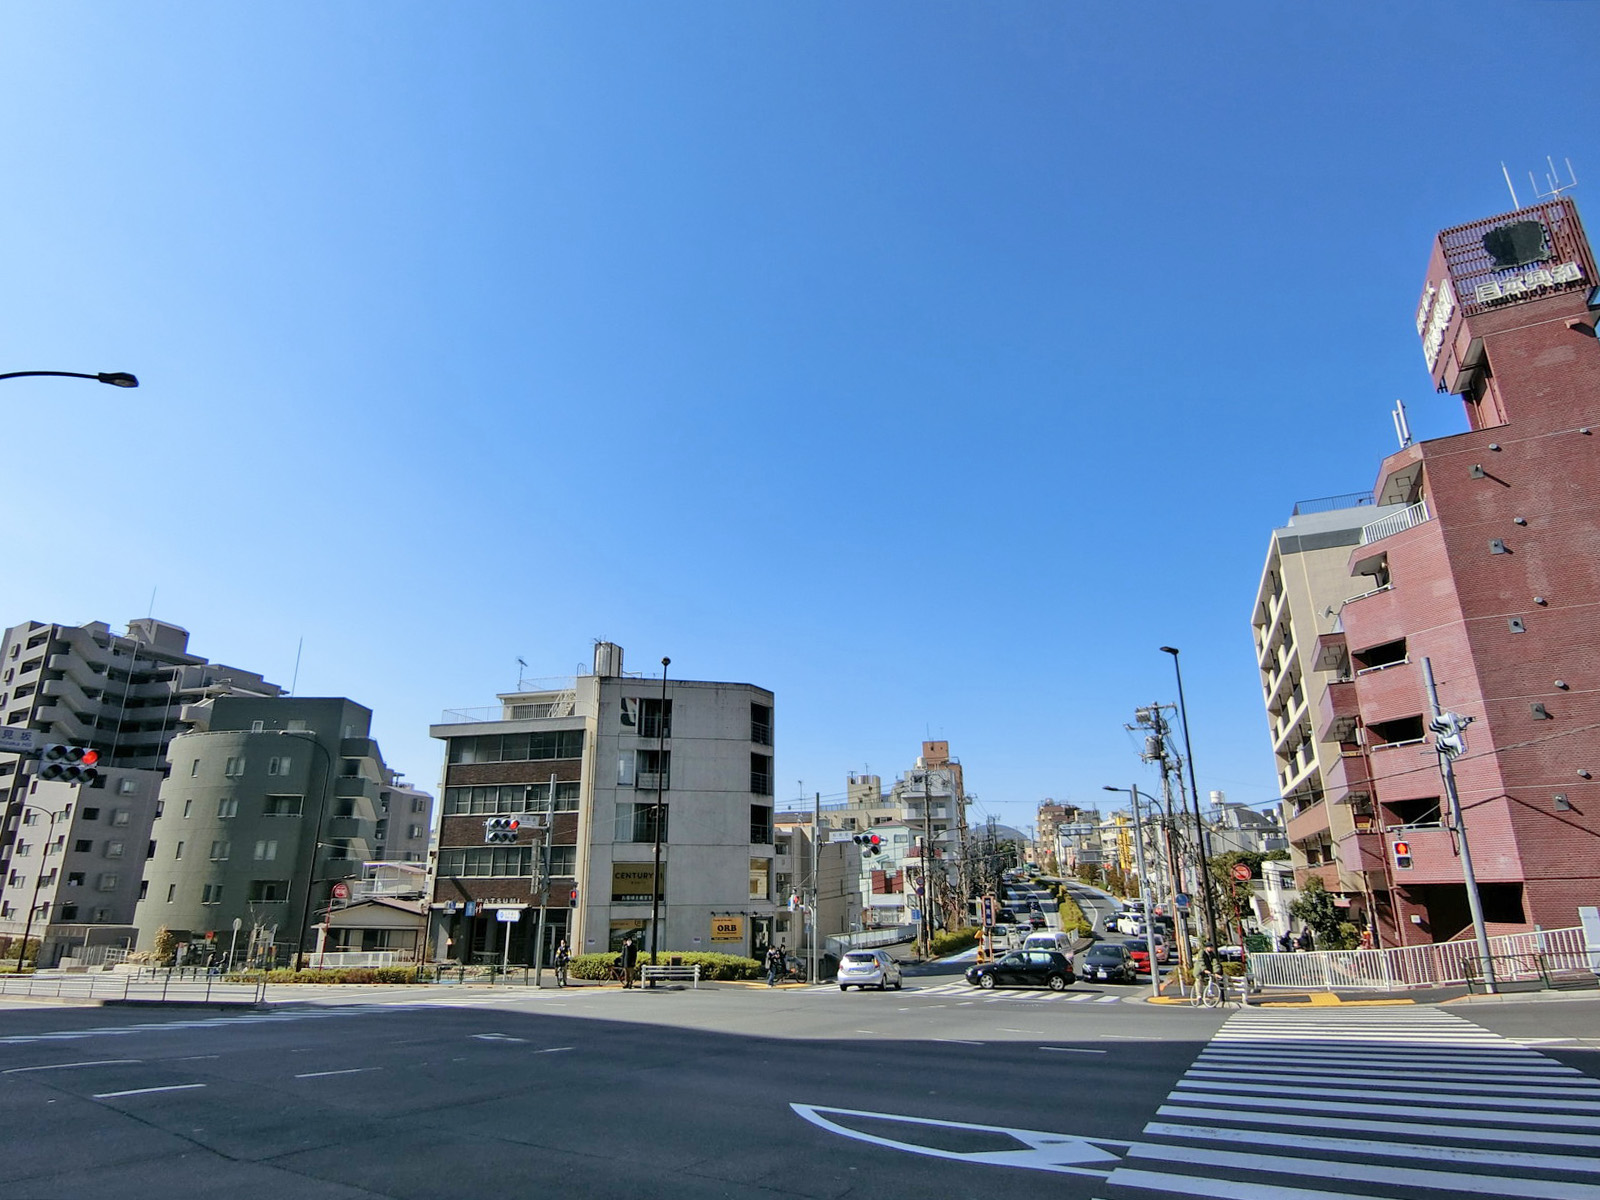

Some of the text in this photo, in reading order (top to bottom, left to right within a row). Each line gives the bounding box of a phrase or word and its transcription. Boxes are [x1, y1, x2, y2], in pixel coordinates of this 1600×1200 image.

[614, 872, 654, 880] CENTURY
[476, 897, 521, 905] MATSUMI
[717, 924, 737, 932] ORB
